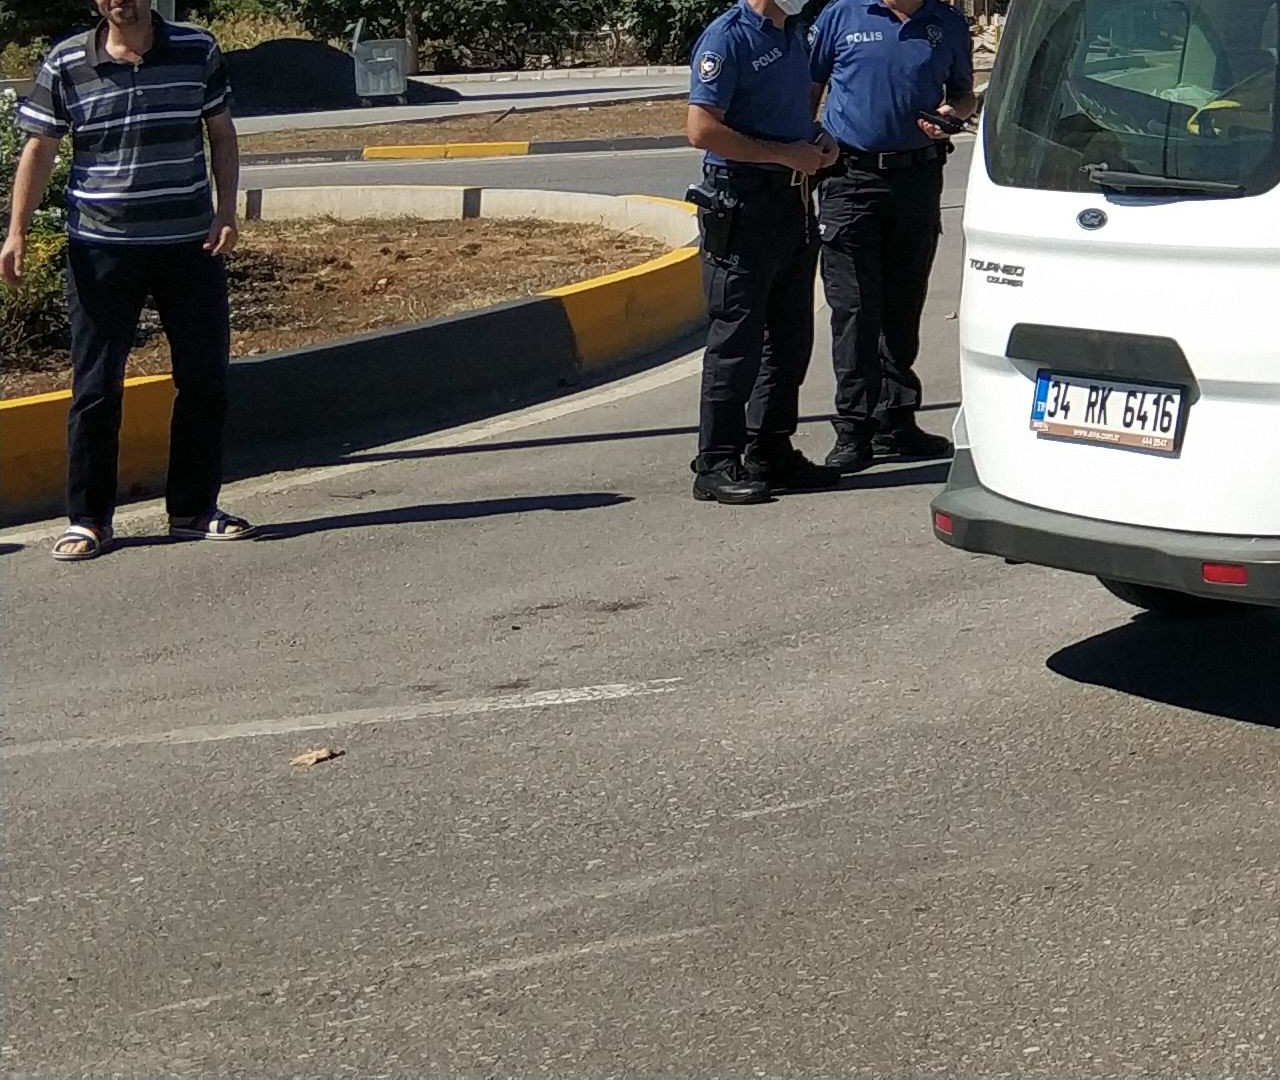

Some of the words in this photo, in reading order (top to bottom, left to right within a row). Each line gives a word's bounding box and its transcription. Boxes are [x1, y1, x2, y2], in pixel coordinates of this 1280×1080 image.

[1047, 380, 1071, 420] 34
[1084, 384, 1113, 426] RK
[1122, 389, 1175, 434] 6416
